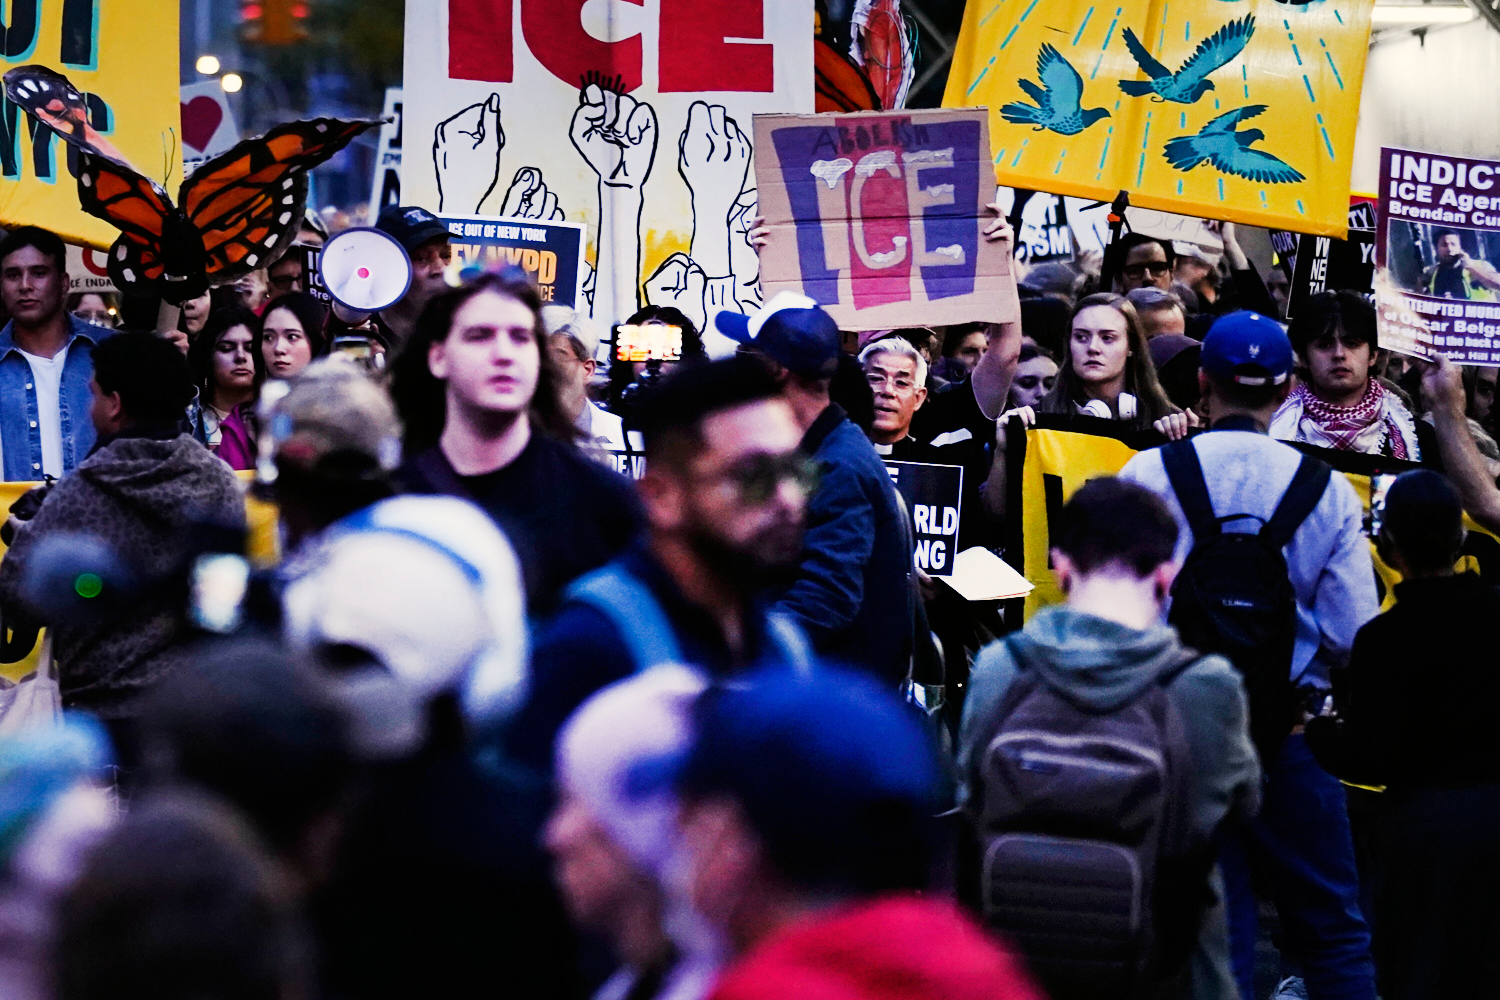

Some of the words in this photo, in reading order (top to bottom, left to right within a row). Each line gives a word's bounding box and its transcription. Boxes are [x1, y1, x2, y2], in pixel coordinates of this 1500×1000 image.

[812, 118, 930, 155] ABOLISH
[810, 147, 966, 271] ICE
[1390, 180, 1433, 203] ICE
[1439, 188, 1500, 212] Agen
[1389, 200, 1466, 224] Brendan
[449, 222, 464, 235] ICE
[464, 224, 483, 237] OUT
[484, 225, 496, 238] OF
[497, 226, 520, 239] NEW
[521, 227, 547, 242] YORK
[1400, 312, 1450, 332] Oscar
[1453, 320, 1500, 338] Belga
